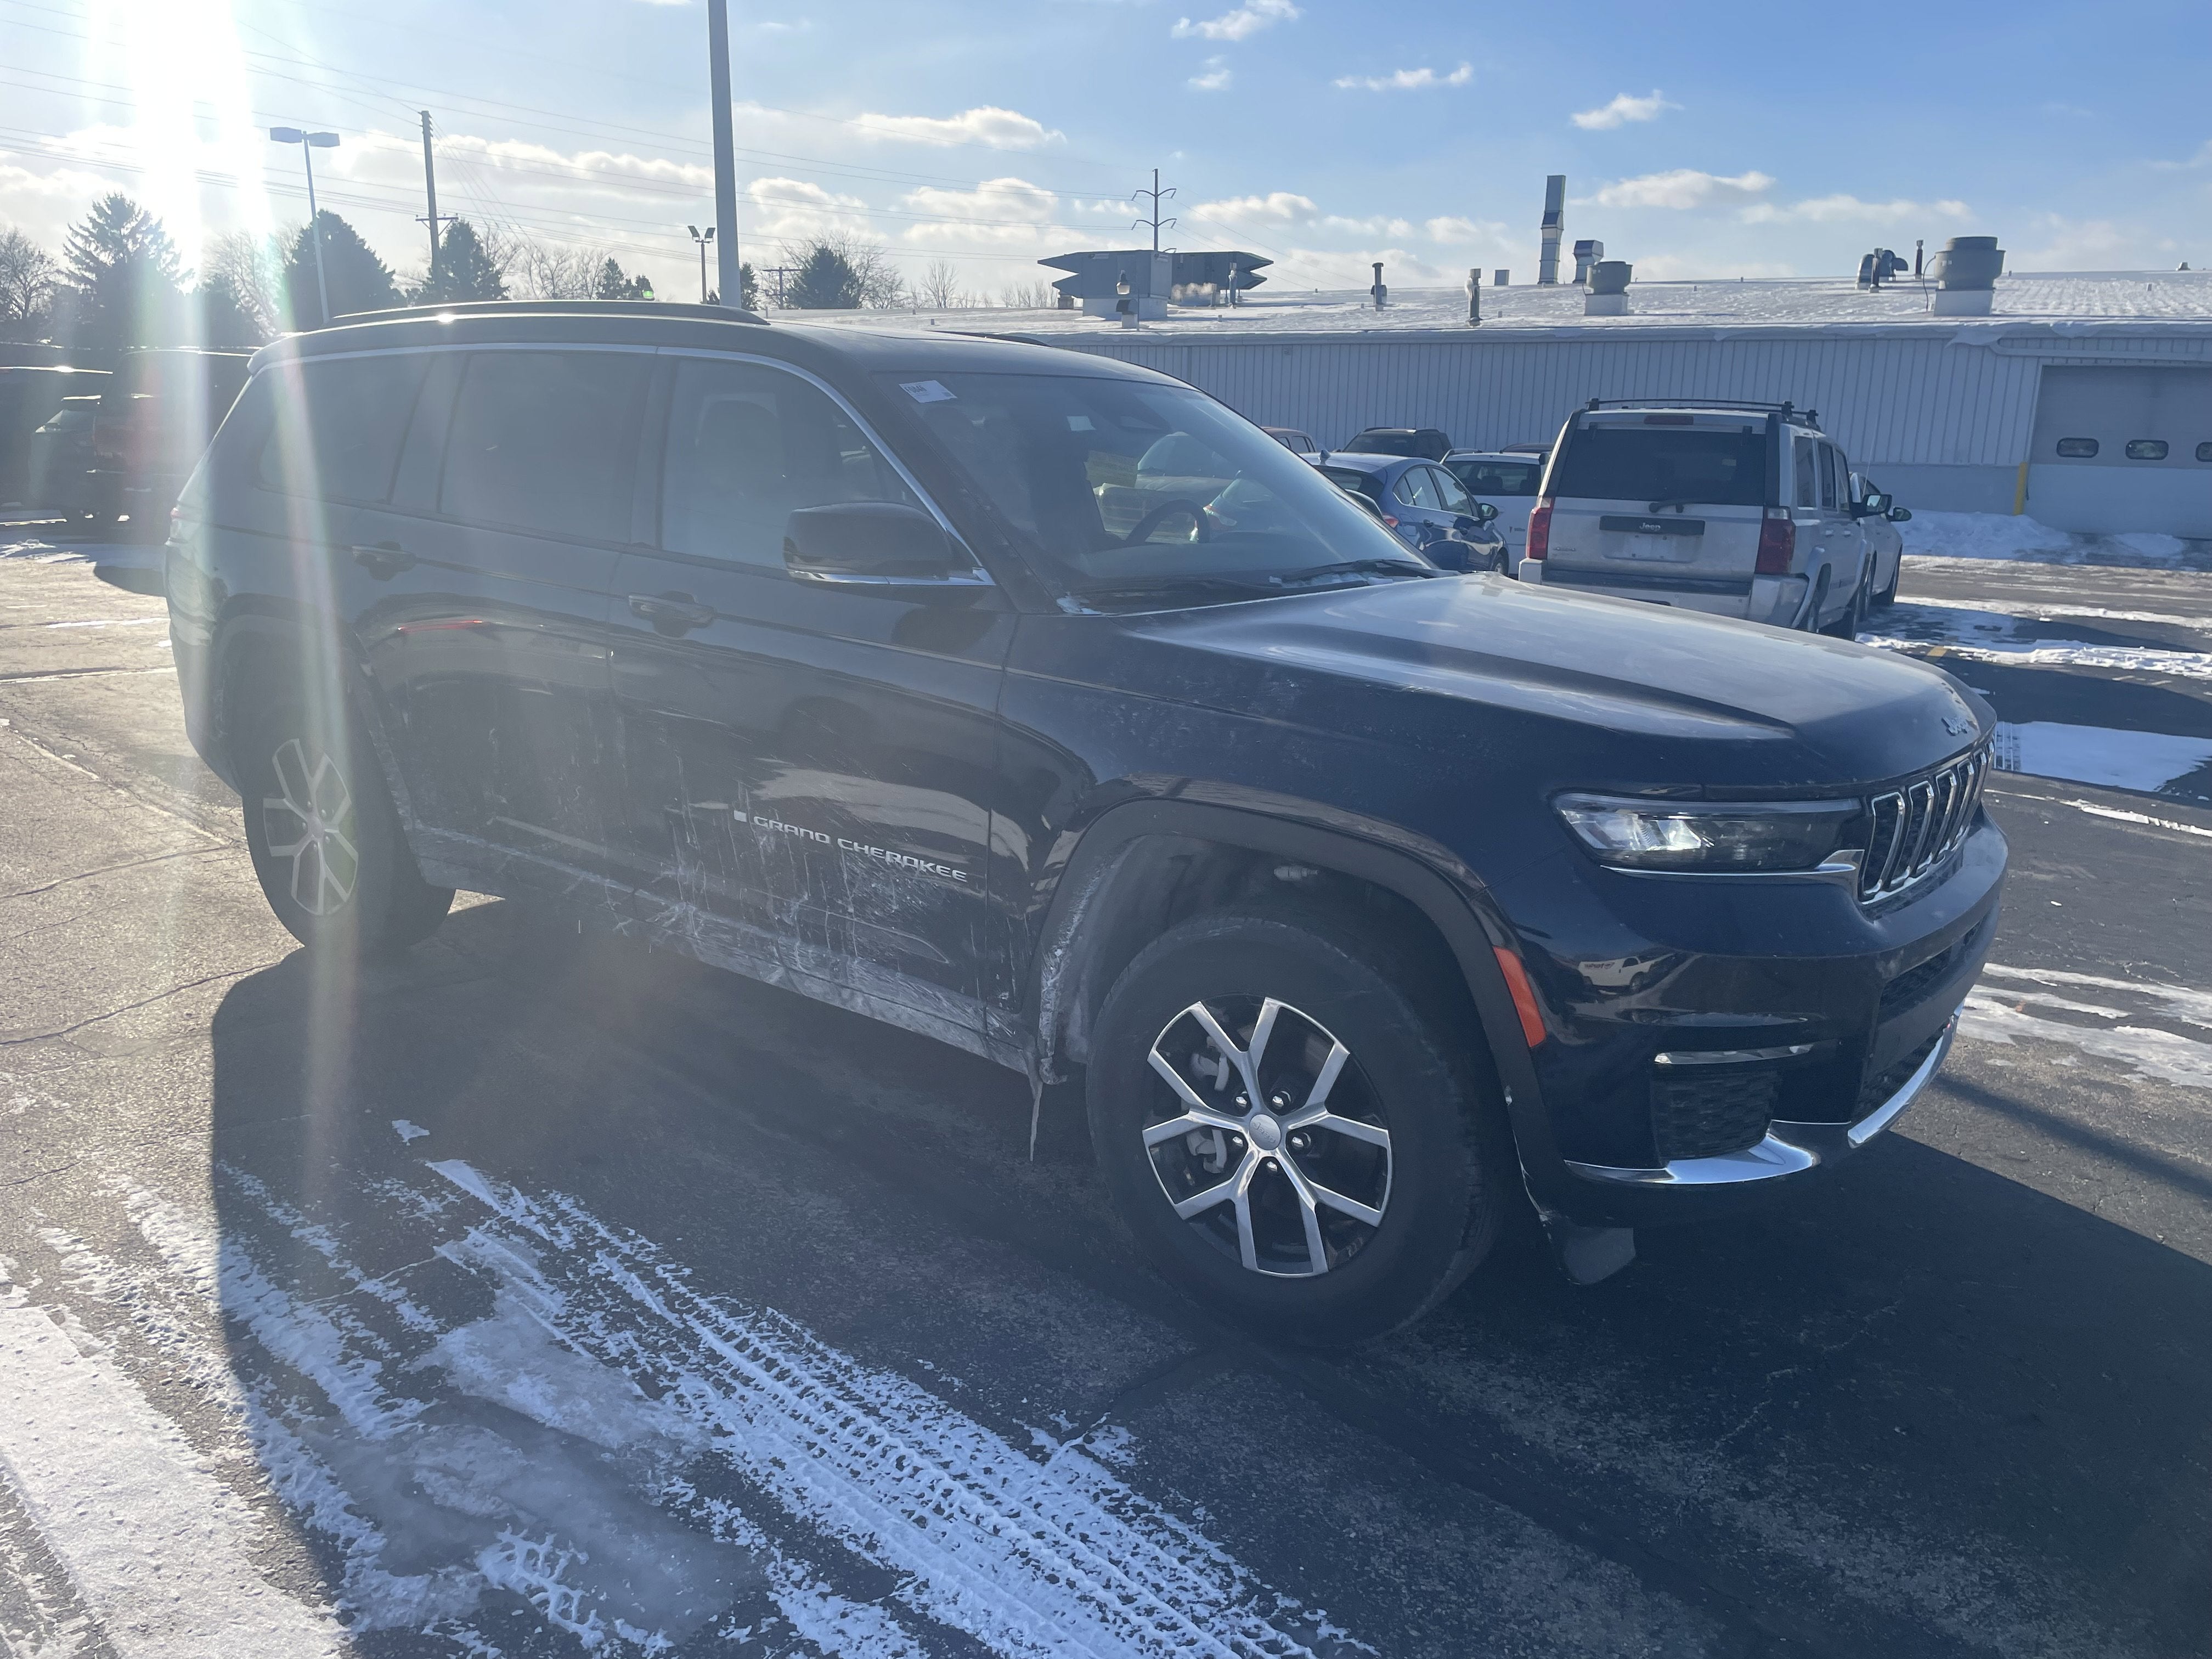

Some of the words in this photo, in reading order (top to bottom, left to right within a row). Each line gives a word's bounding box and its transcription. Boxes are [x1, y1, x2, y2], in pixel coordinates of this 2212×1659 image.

[1639, 522, 1661, 532] Jeep
[754, 816, 831, 844] GRAND
[838, 838, 968, 883] CHEROKEE
[1253, 1122, 1276, 1143] Jeep
